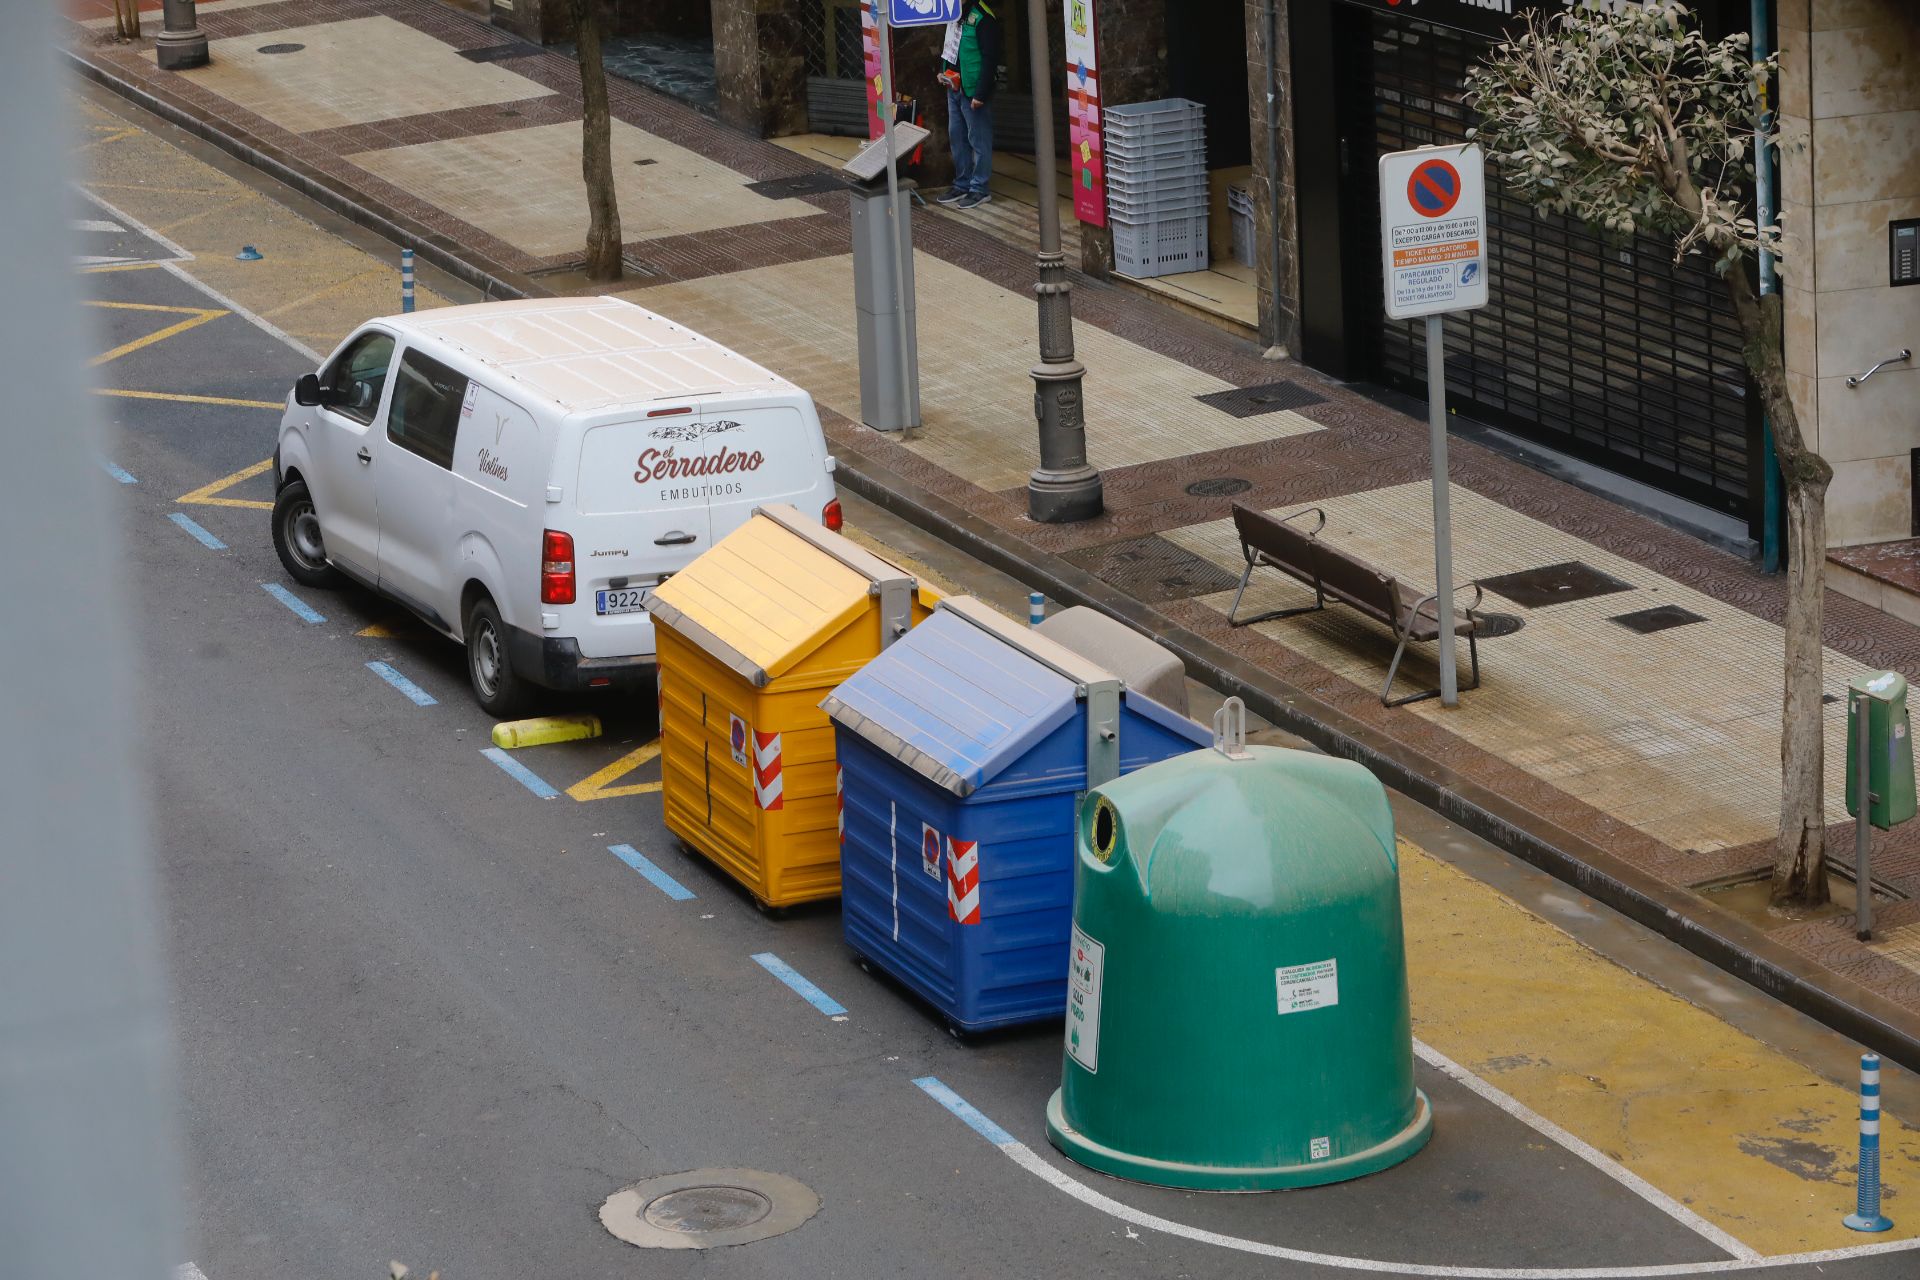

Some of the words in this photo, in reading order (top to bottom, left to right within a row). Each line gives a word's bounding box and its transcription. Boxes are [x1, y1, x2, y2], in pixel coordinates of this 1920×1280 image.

[1395, 235, 1420, 245] EXCEPTO
[1421, 232, 1440, 241] CARGA
[1446, 228, 1476, 238] DESCARGA
[1395, 257, 1417, 266] TIEMPO
[1451, 249, 1477, 259] MINUTOS
[1405, 248, 1427, 257] TICKET
[1427, 243, 1467, 254] OBLIGATORIO
[1400, 267, 1450, 280] APARCAMIENTO
[1408, 275, 1442, 286] REGULADO
[662, 446, 674, 458] el
[478, 448, 508, 481] Violines
[634, 445, 765, 484] Serradero
[660, 482, 742, 501] EMBUTIDOS
[590, 549, 629, 557] Jumpy
